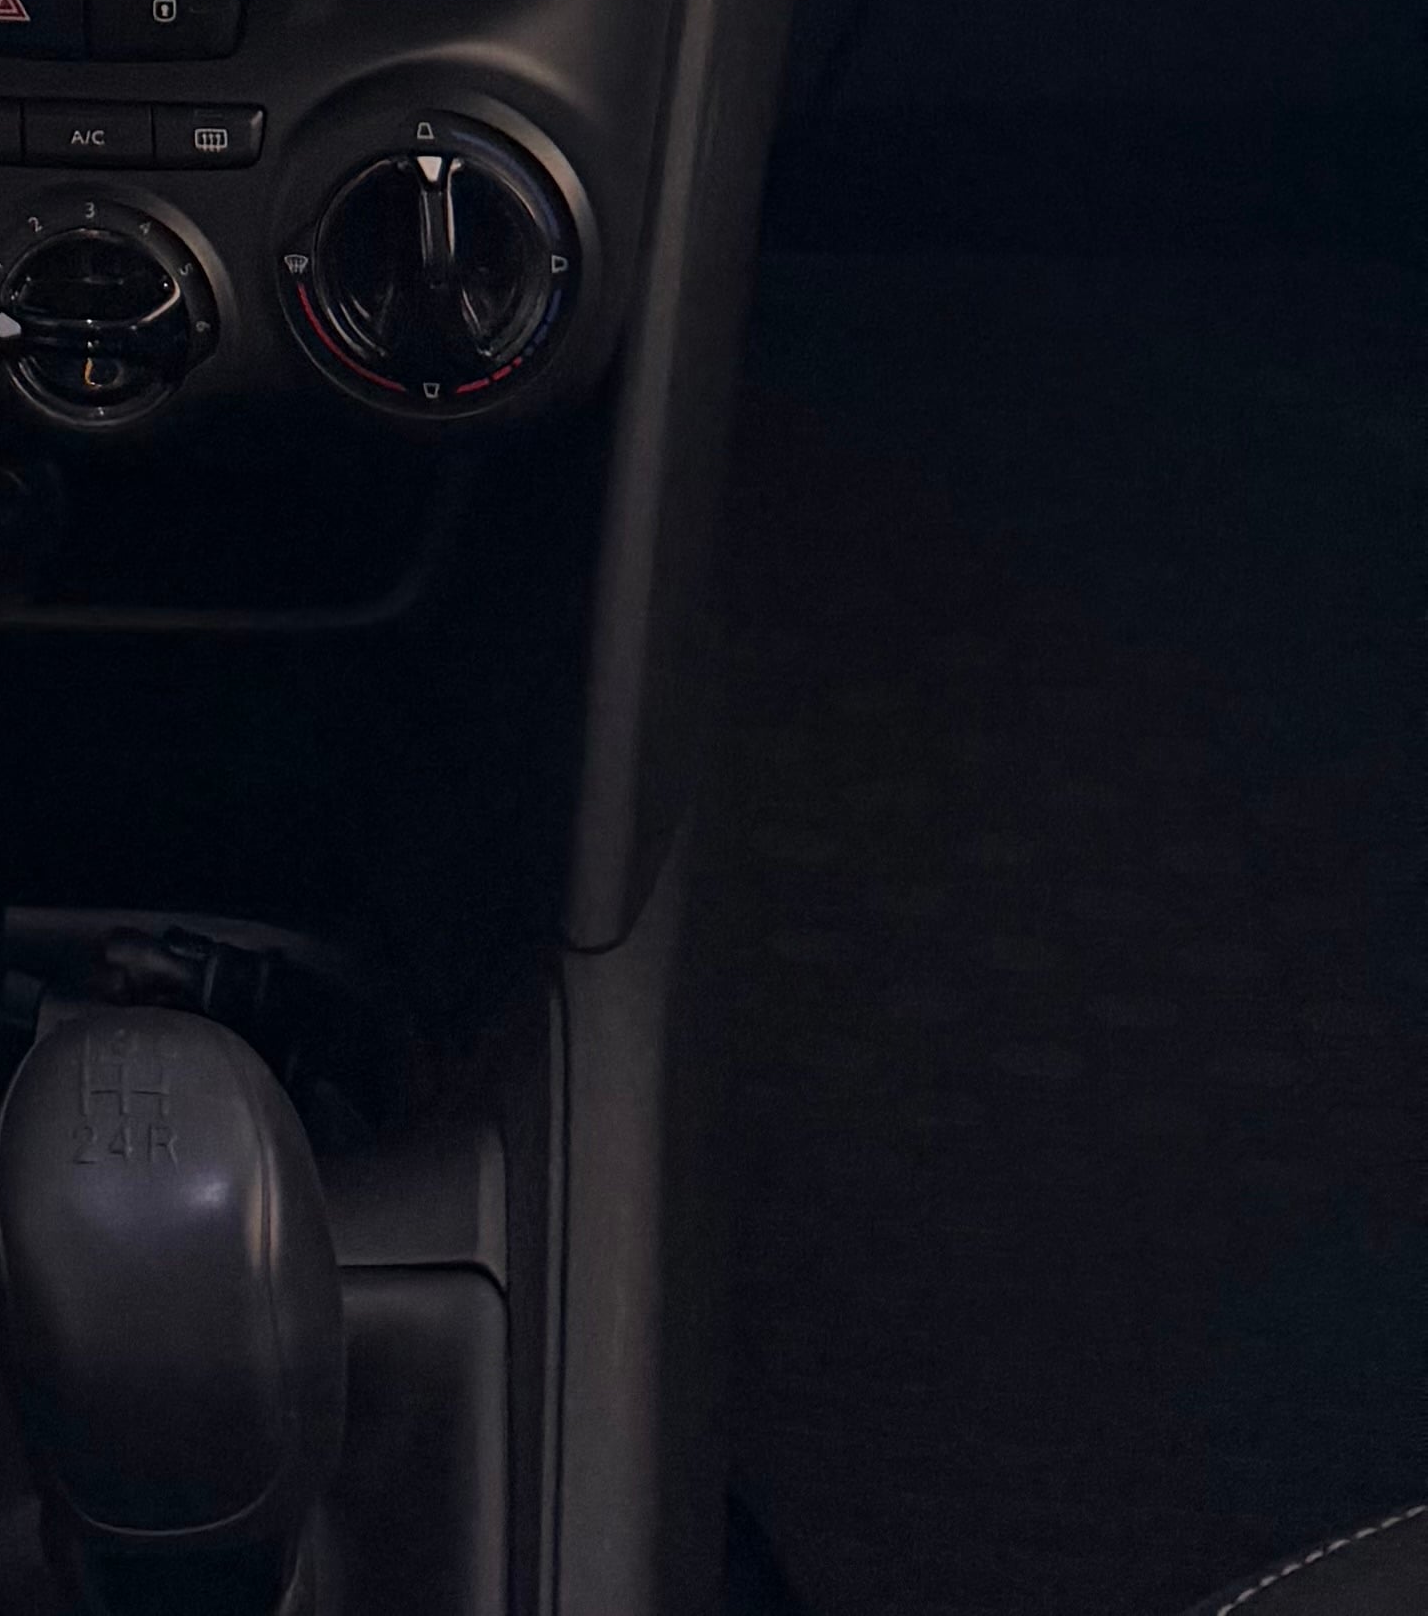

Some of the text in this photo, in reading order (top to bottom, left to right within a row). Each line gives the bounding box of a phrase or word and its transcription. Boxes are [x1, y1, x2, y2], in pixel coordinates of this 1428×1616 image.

[71, 129, 106, 146] A/C
[85, 202, 95, 219] 3
[27, 216, 43, 234] 2
